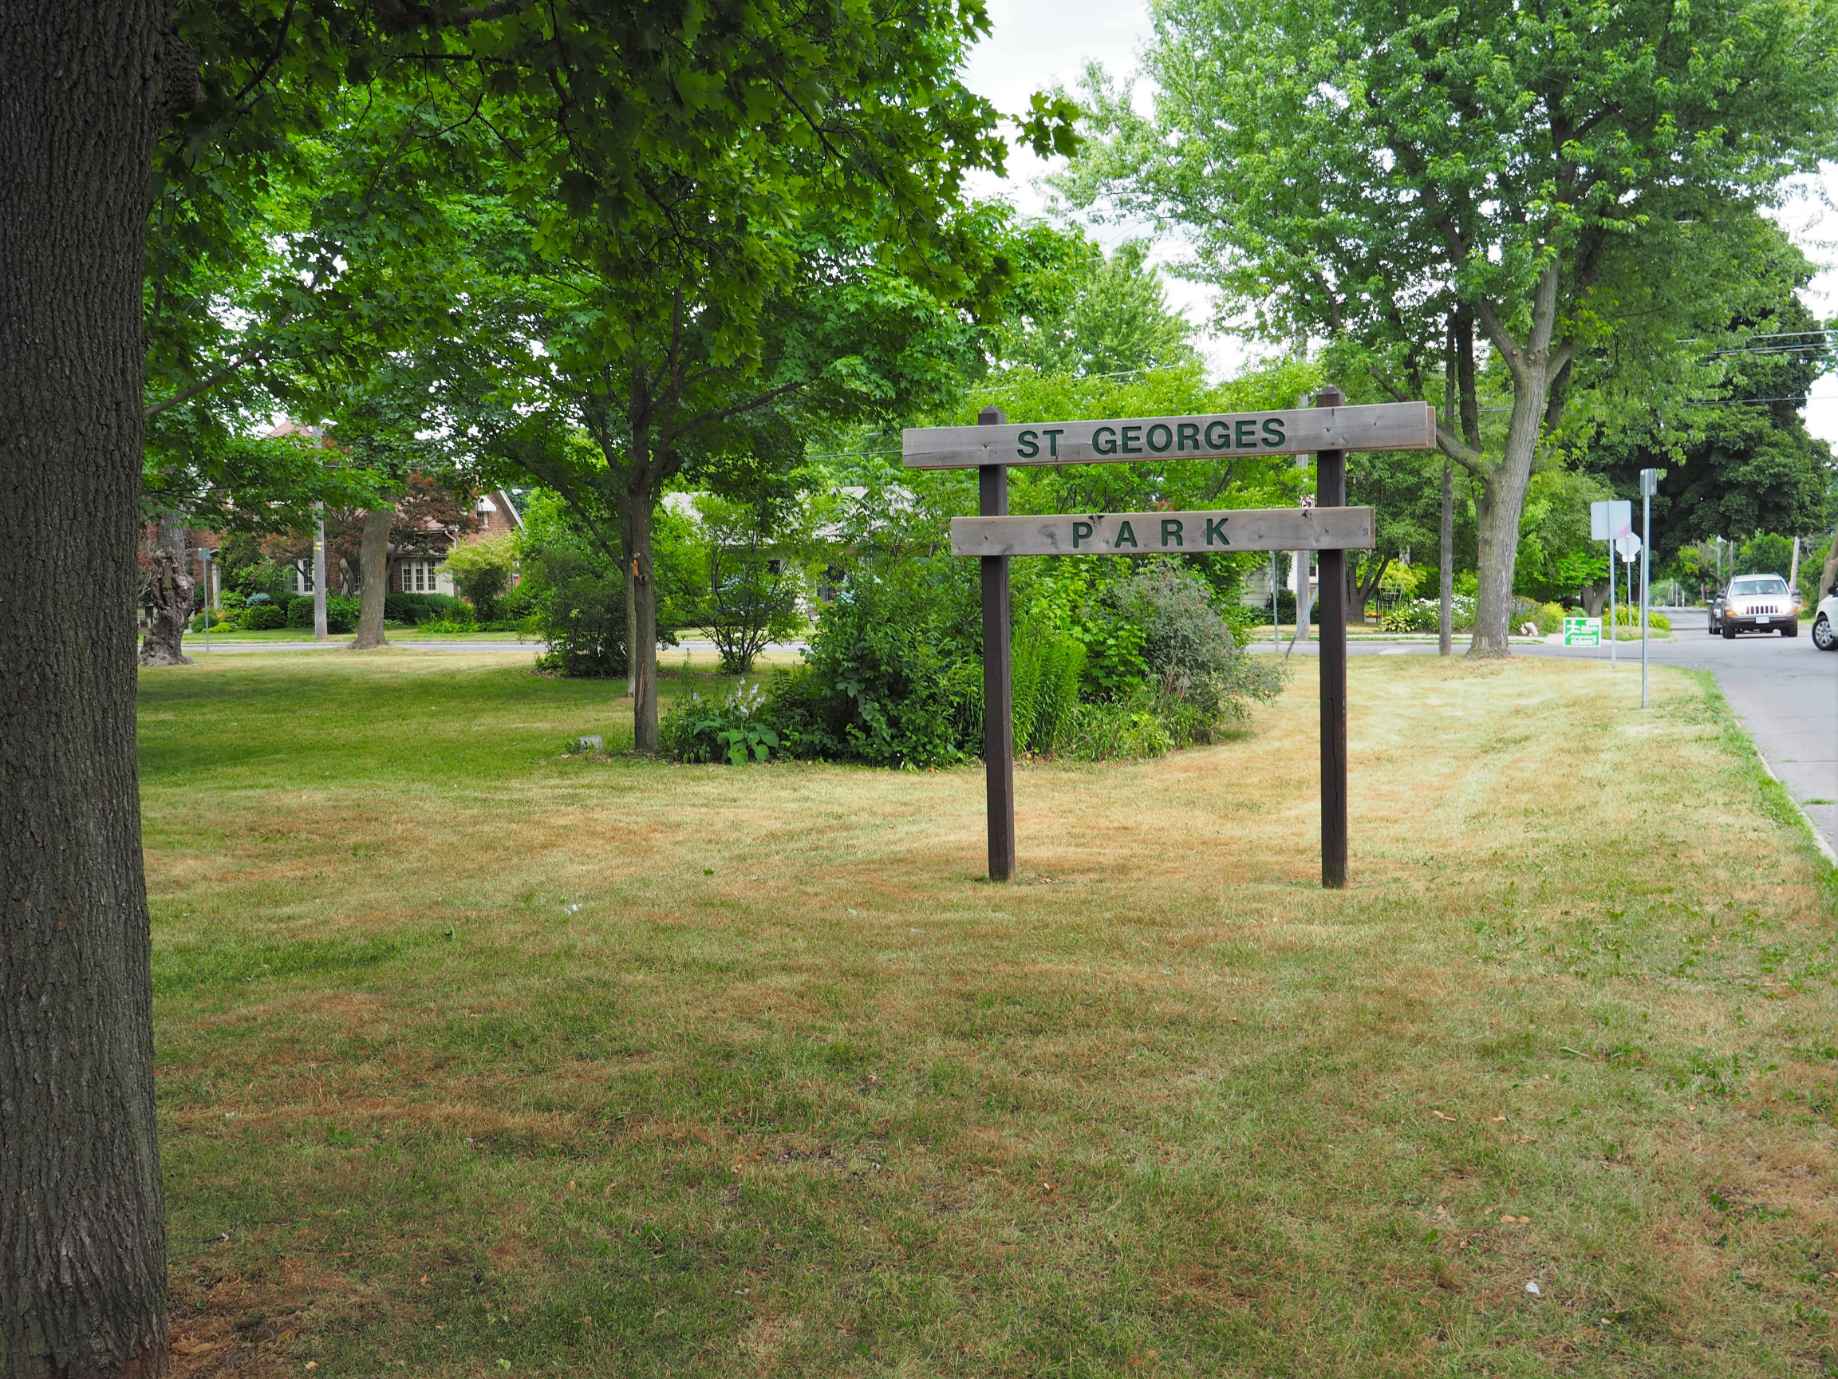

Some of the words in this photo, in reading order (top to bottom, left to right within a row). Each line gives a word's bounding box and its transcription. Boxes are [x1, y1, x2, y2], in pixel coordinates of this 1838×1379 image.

[1017, 429, 1063, 458] ST
[1092, 418, 1286, 455] GEORGES
[1072, 517, 1231, 548] PARK
